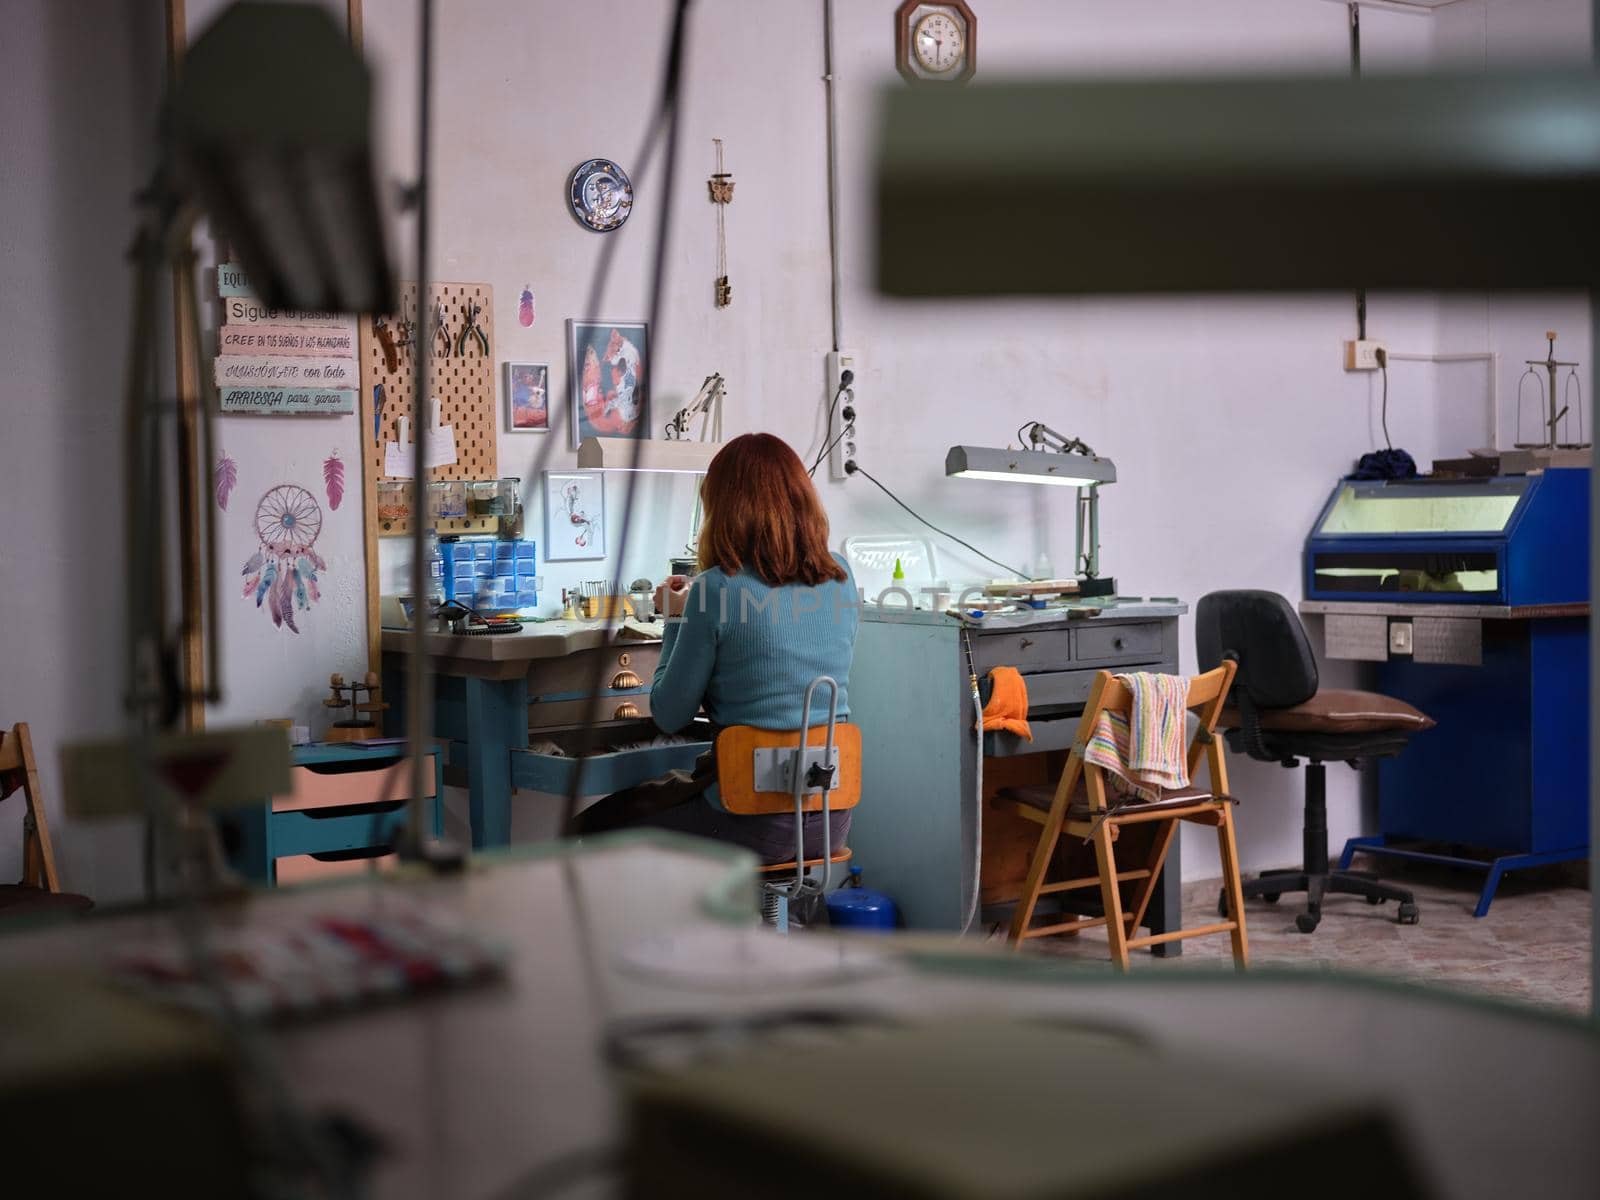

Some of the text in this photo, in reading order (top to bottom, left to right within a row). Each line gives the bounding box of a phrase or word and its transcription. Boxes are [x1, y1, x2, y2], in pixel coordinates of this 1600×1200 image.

[232, 302, 278, 321] Sigue
[225, 334, 255, 345] CREE
[304, 368, 321, 378] con
[225, 391, 342, 406] ARRIESGA para ganar
